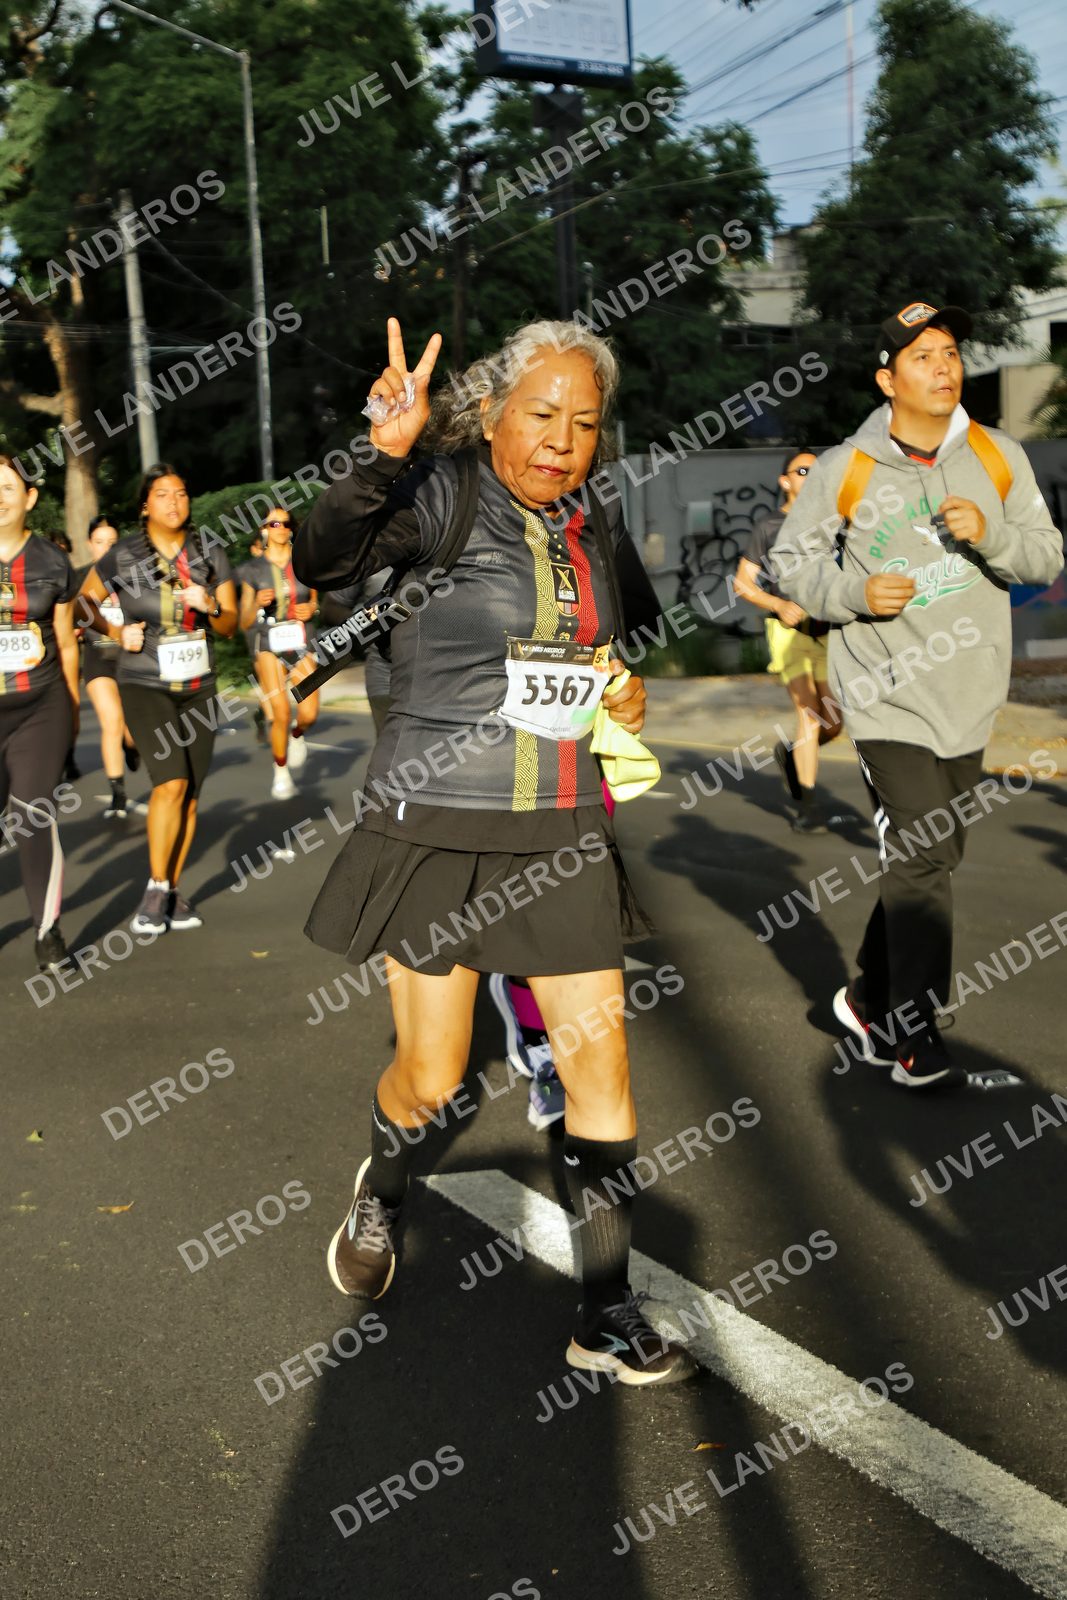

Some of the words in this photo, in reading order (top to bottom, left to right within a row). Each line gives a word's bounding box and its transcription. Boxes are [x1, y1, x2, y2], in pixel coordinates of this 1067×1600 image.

[881, 552, 976, 600] agle
[318, 610, 373, 653] BIMBA
[168, 646, 203, 665] 7499
[522, 645, 543, 653] LENES
[521, 674, 595, 706] 5567
